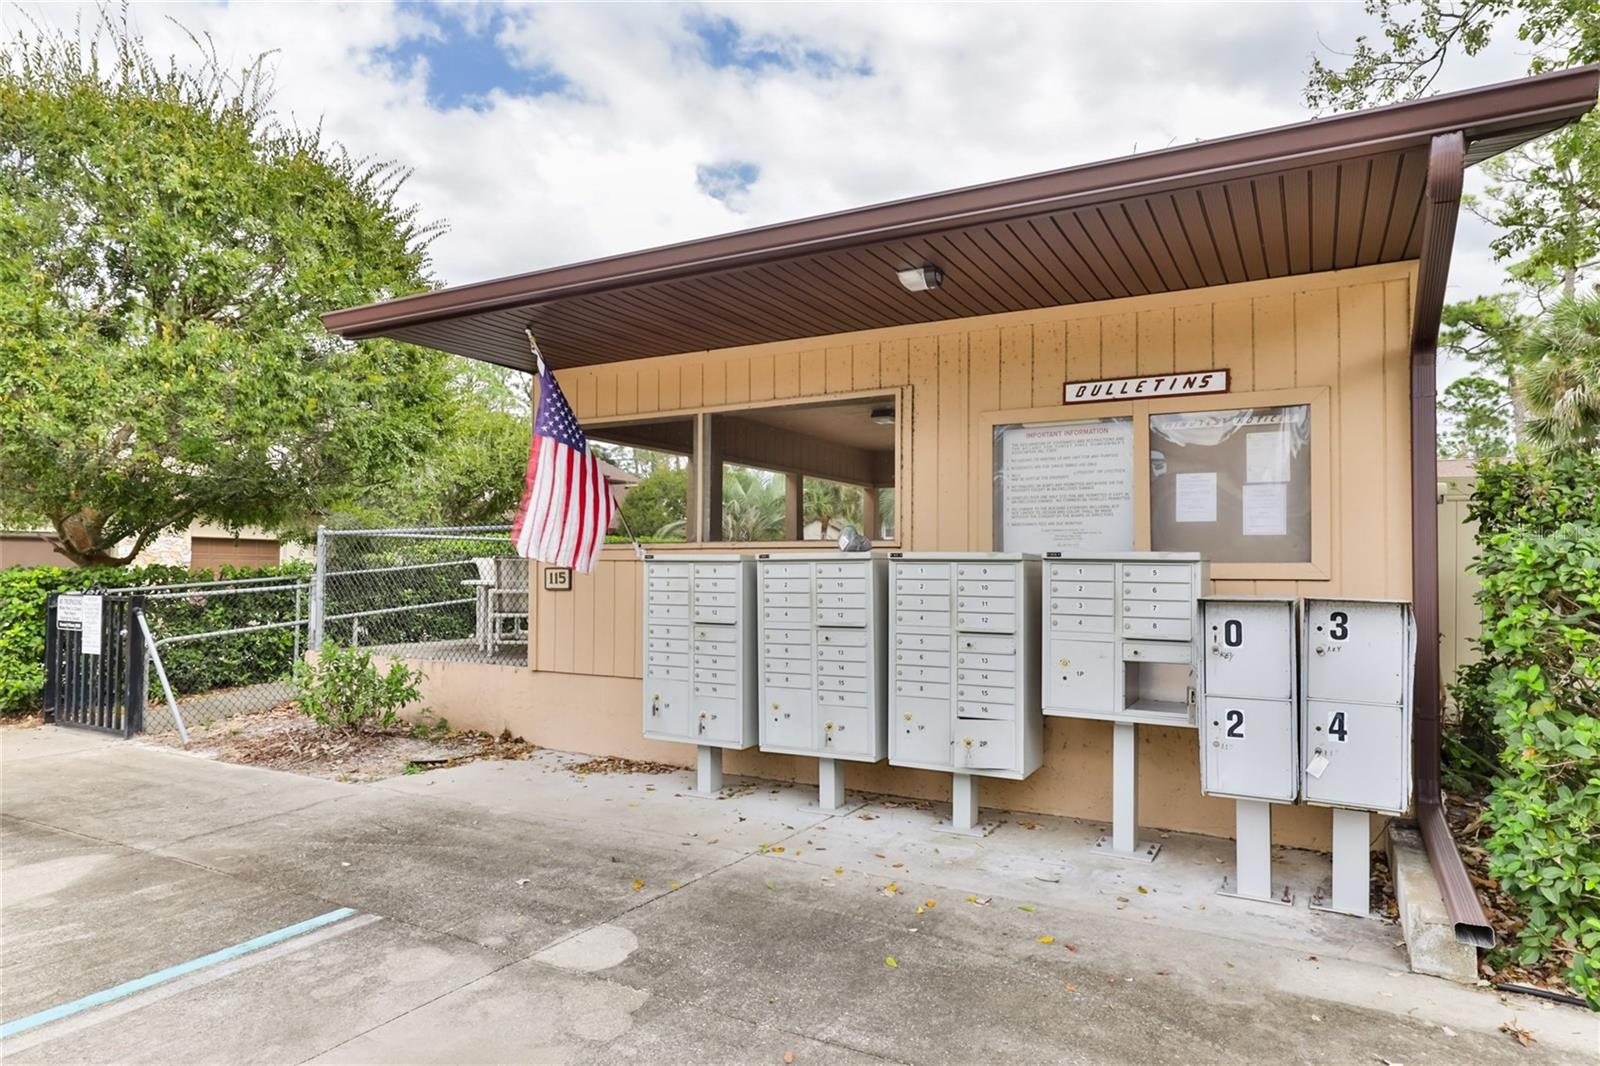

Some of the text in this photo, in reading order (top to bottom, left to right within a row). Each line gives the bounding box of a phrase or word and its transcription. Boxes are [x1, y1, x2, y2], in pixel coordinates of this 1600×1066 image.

[1075, 375, 1213, 398] BULLETINS
[1025, 426, 1109, 439] IMPORTANT INFORMATION
[549, 571, 567, 585] 115
[1224, 619, 1243, 648] 0
[1329, 611, 1349, 641] 3
[1226, 709, 1244, 739] 2
[1328, 711, 1348, 742] 4
